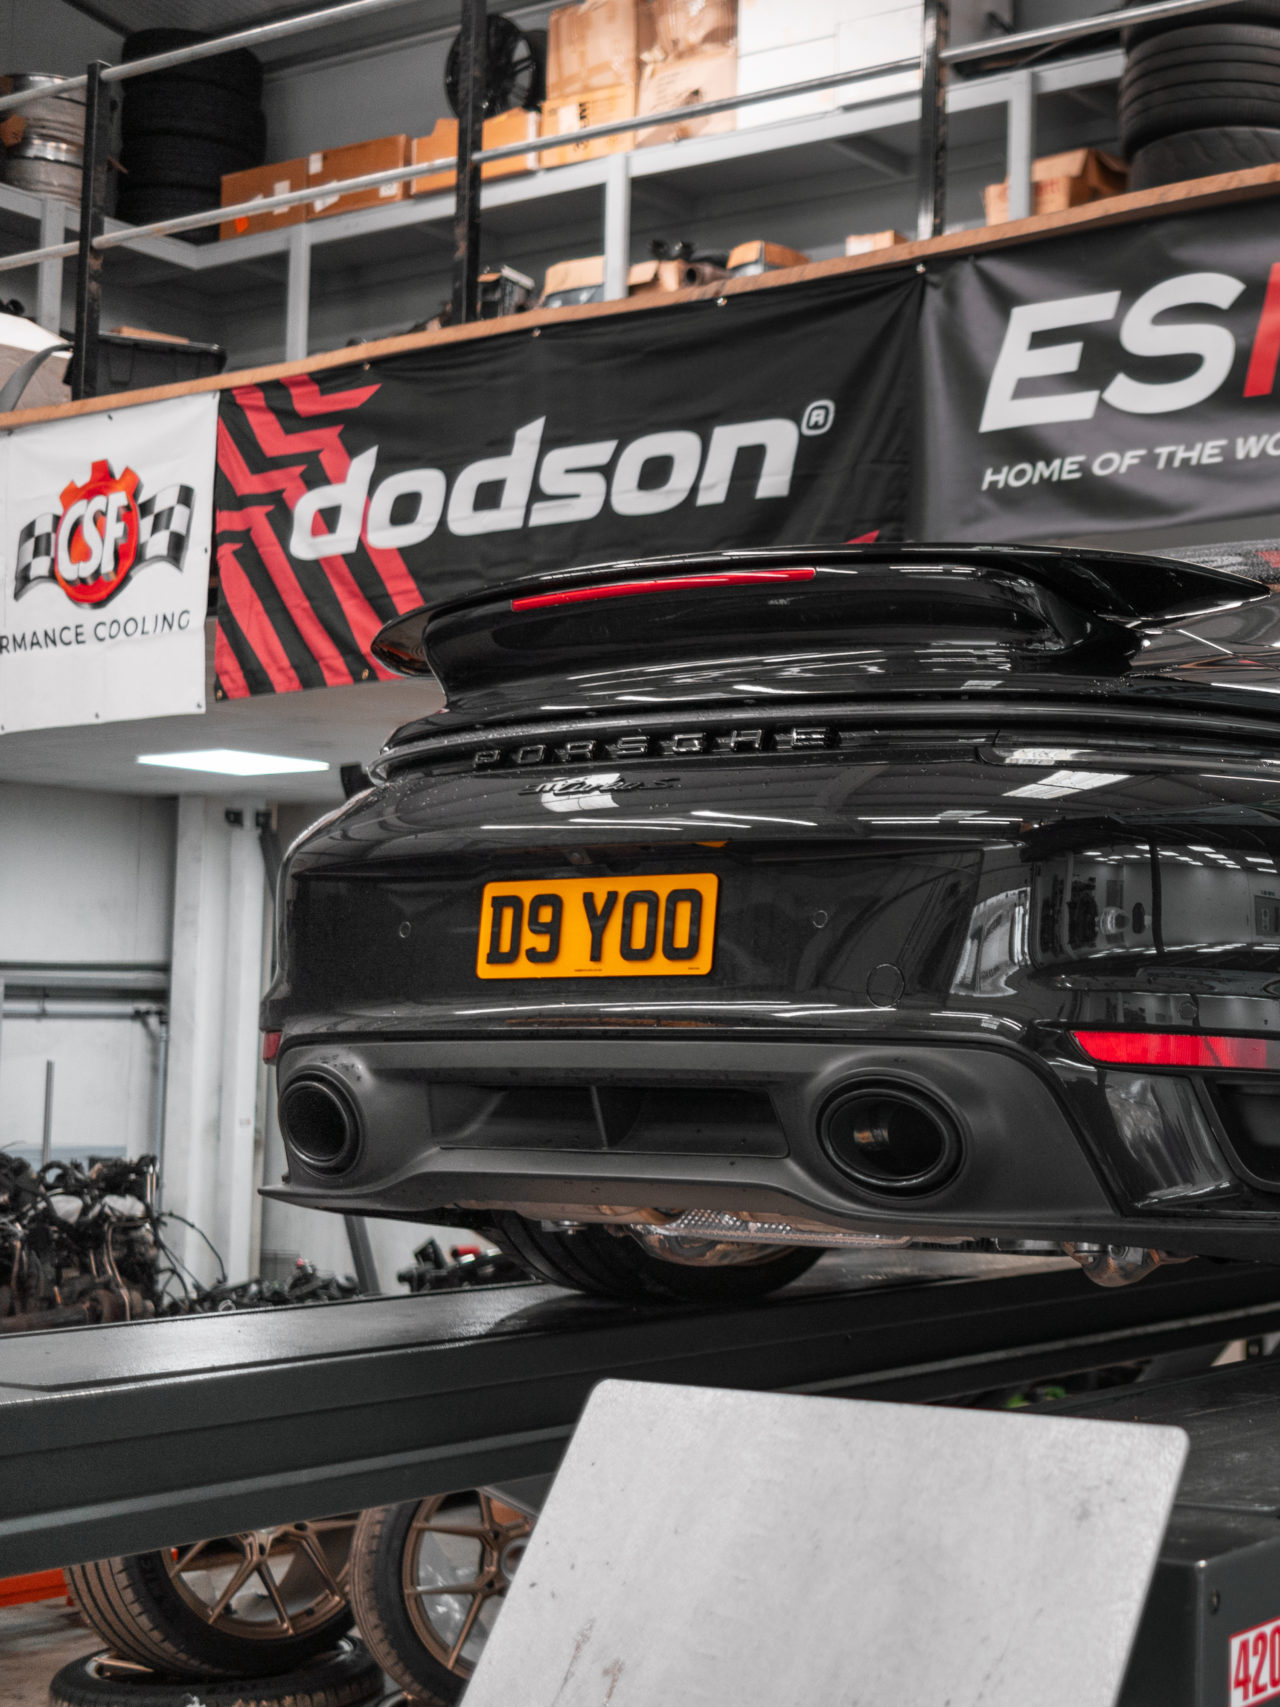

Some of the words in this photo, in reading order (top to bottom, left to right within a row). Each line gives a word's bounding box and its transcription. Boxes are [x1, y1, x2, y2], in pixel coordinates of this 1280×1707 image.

[982, 455, 1084, 491] HOME
[1092, 448, 1146, 476] OF
[1153, 440, 1228, 469] THE
[57, 490, 134, 586] CSF
[94, 609, 191, 643] COOLING
[473, 726, 829, 769] PORSCHE
[486, 893, 564, 965] D9
